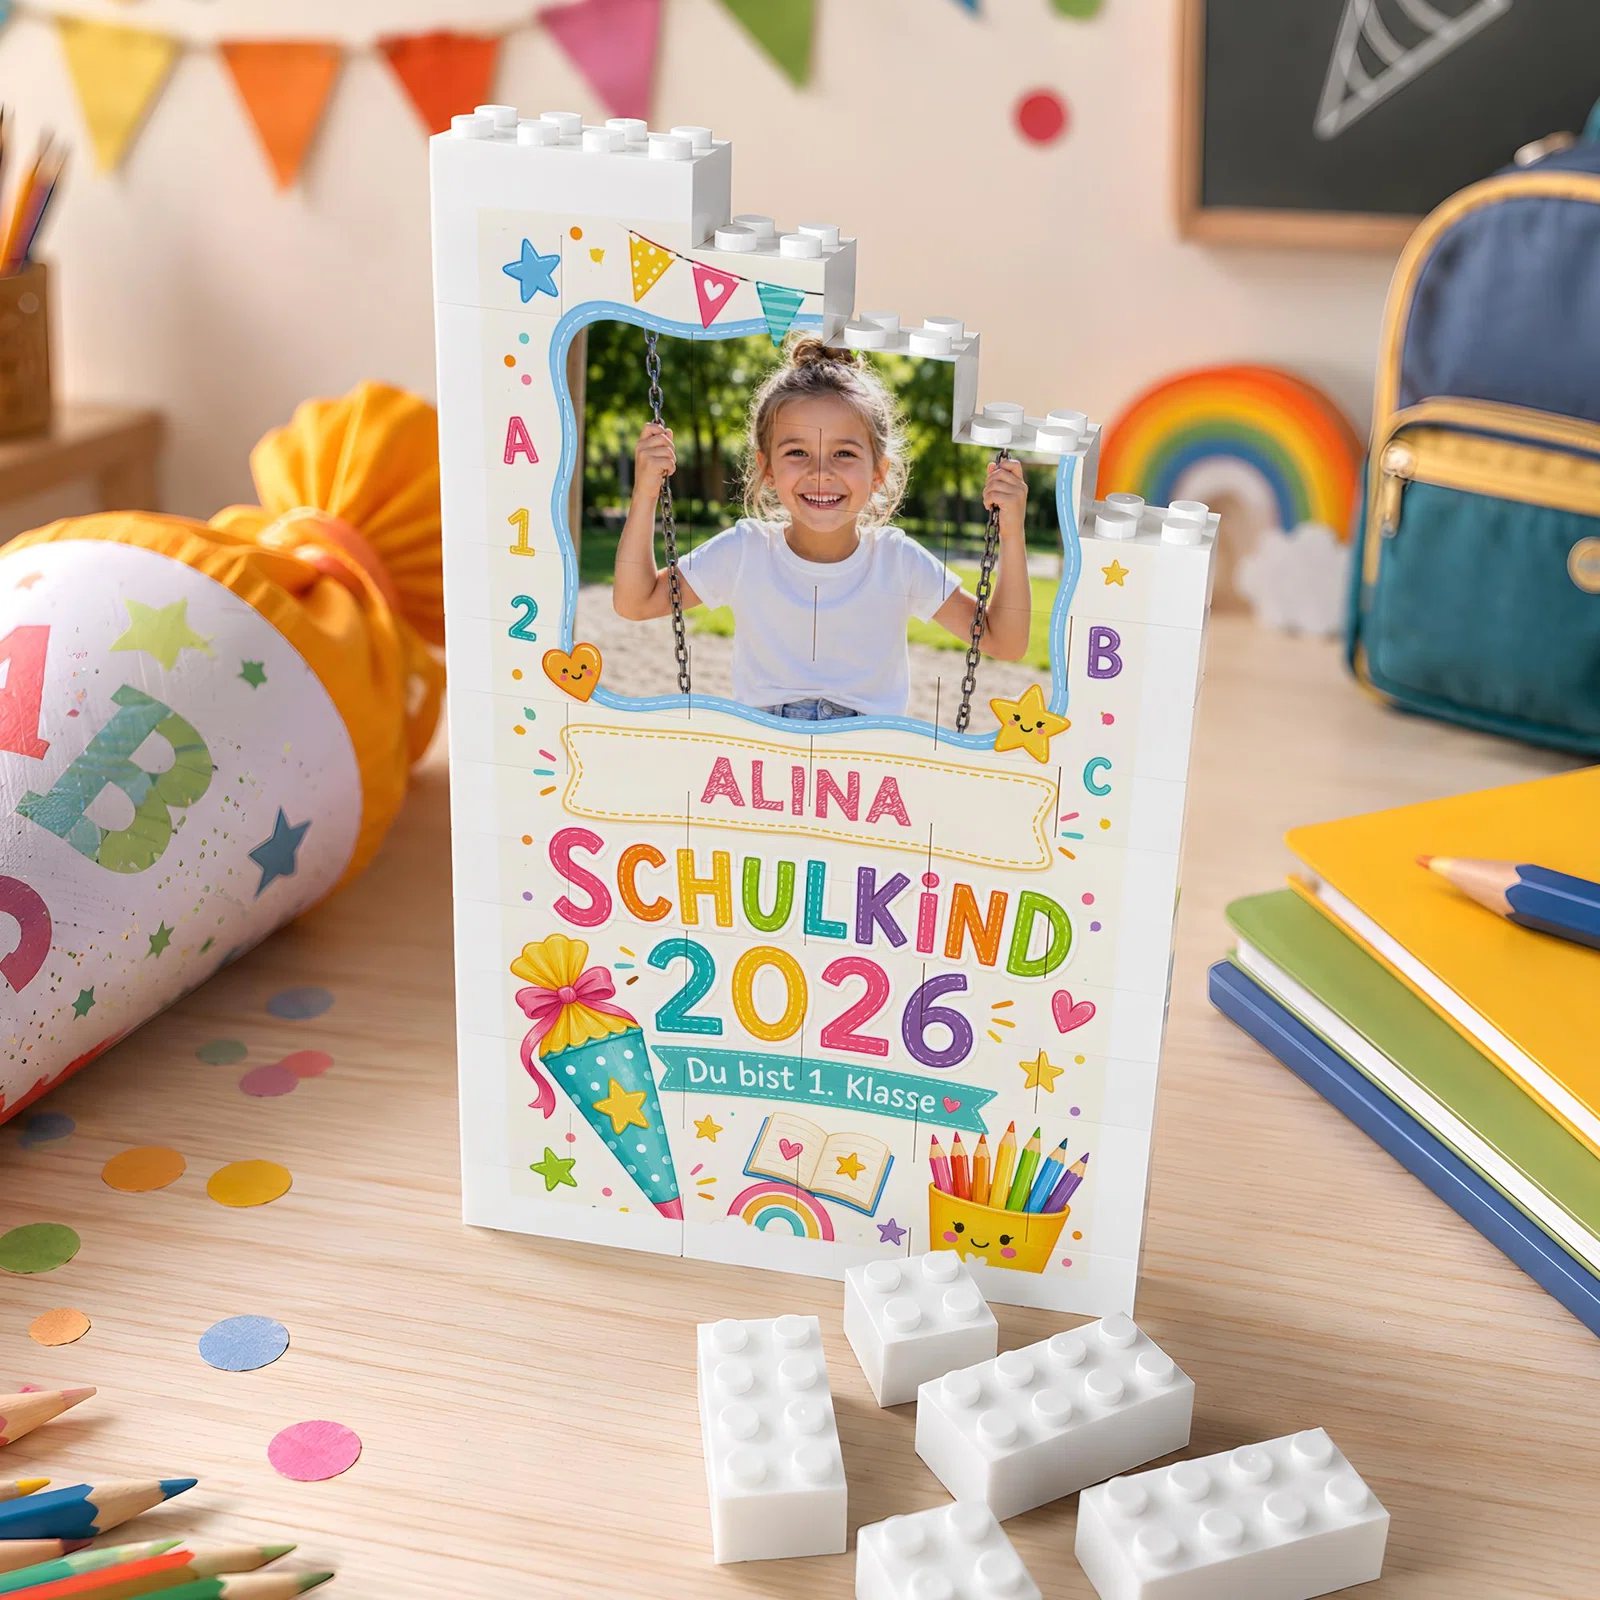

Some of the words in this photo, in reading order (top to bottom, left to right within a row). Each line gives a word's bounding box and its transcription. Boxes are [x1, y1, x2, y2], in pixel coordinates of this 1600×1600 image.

[503, 415, 540, 465] A
[507, 507, 536, 557] 1
[508, 594, 539, 642] 2
[1087, 626, 1123, 680] B
[15, 684, 214, 874] B
[700, 756, 911, 827] ALINA
[1083, 756, 1113, 797] C
[647, 937, 974, 1068] 2026
[687, 1056, 727, 1085] Du
[738, 1060, 796, 1091] bist
[808, 1068, 834, 1097] 1.
[846, 1073, 936, 1114] Klasse
